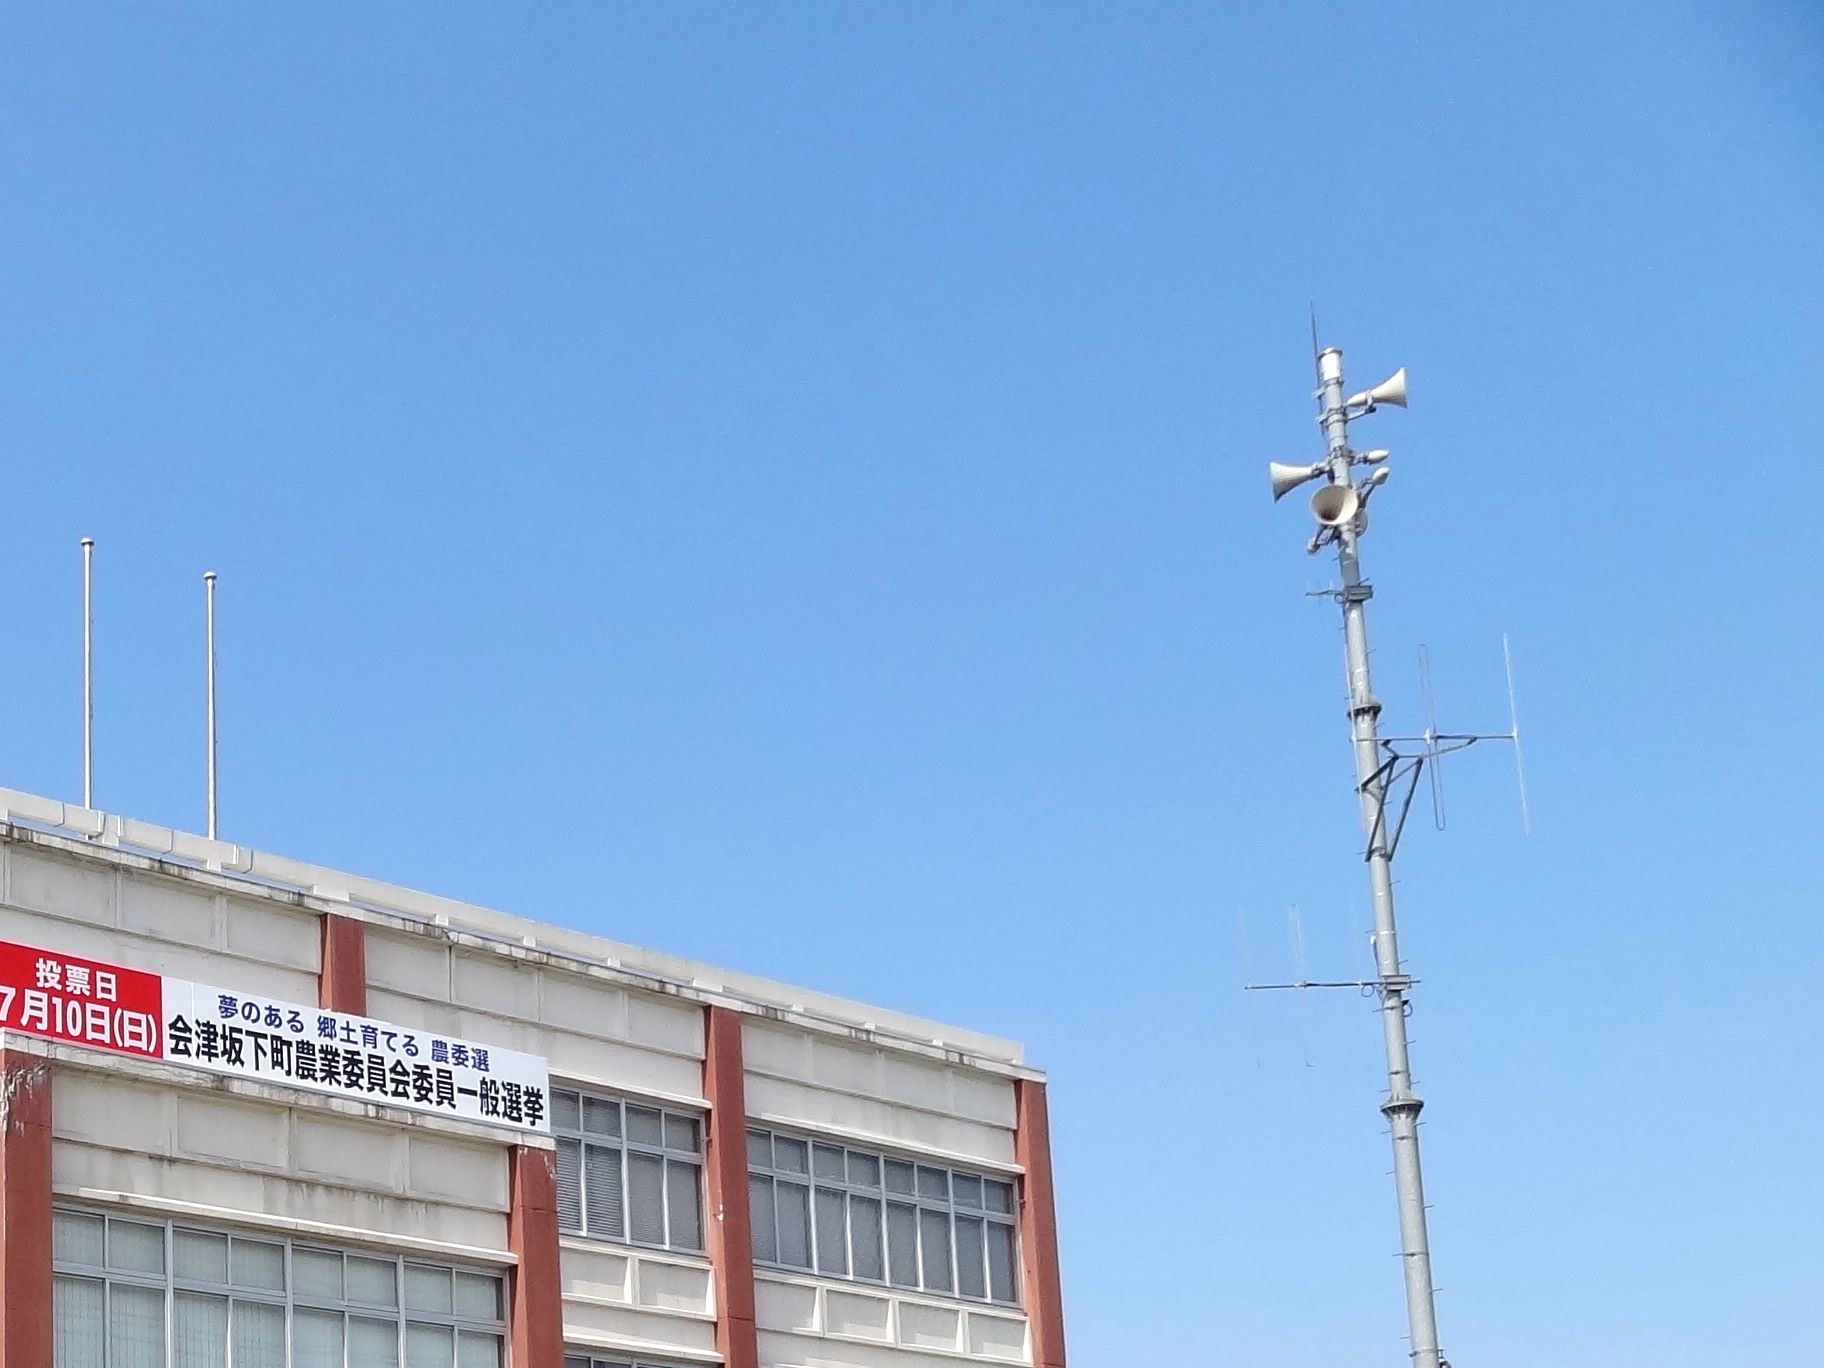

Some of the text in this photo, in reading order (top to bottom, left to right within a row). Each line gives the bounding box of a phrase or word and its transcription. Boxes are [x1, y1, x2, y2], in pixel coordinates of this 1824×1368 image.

[35, 957, 117, 1003] 投票日
[167, 1013, 545, 1128] 会津坂下町農業委員会委員一般選挙
[217, 993, 491, 1073] 夢のある 郷土育てる 農委選
